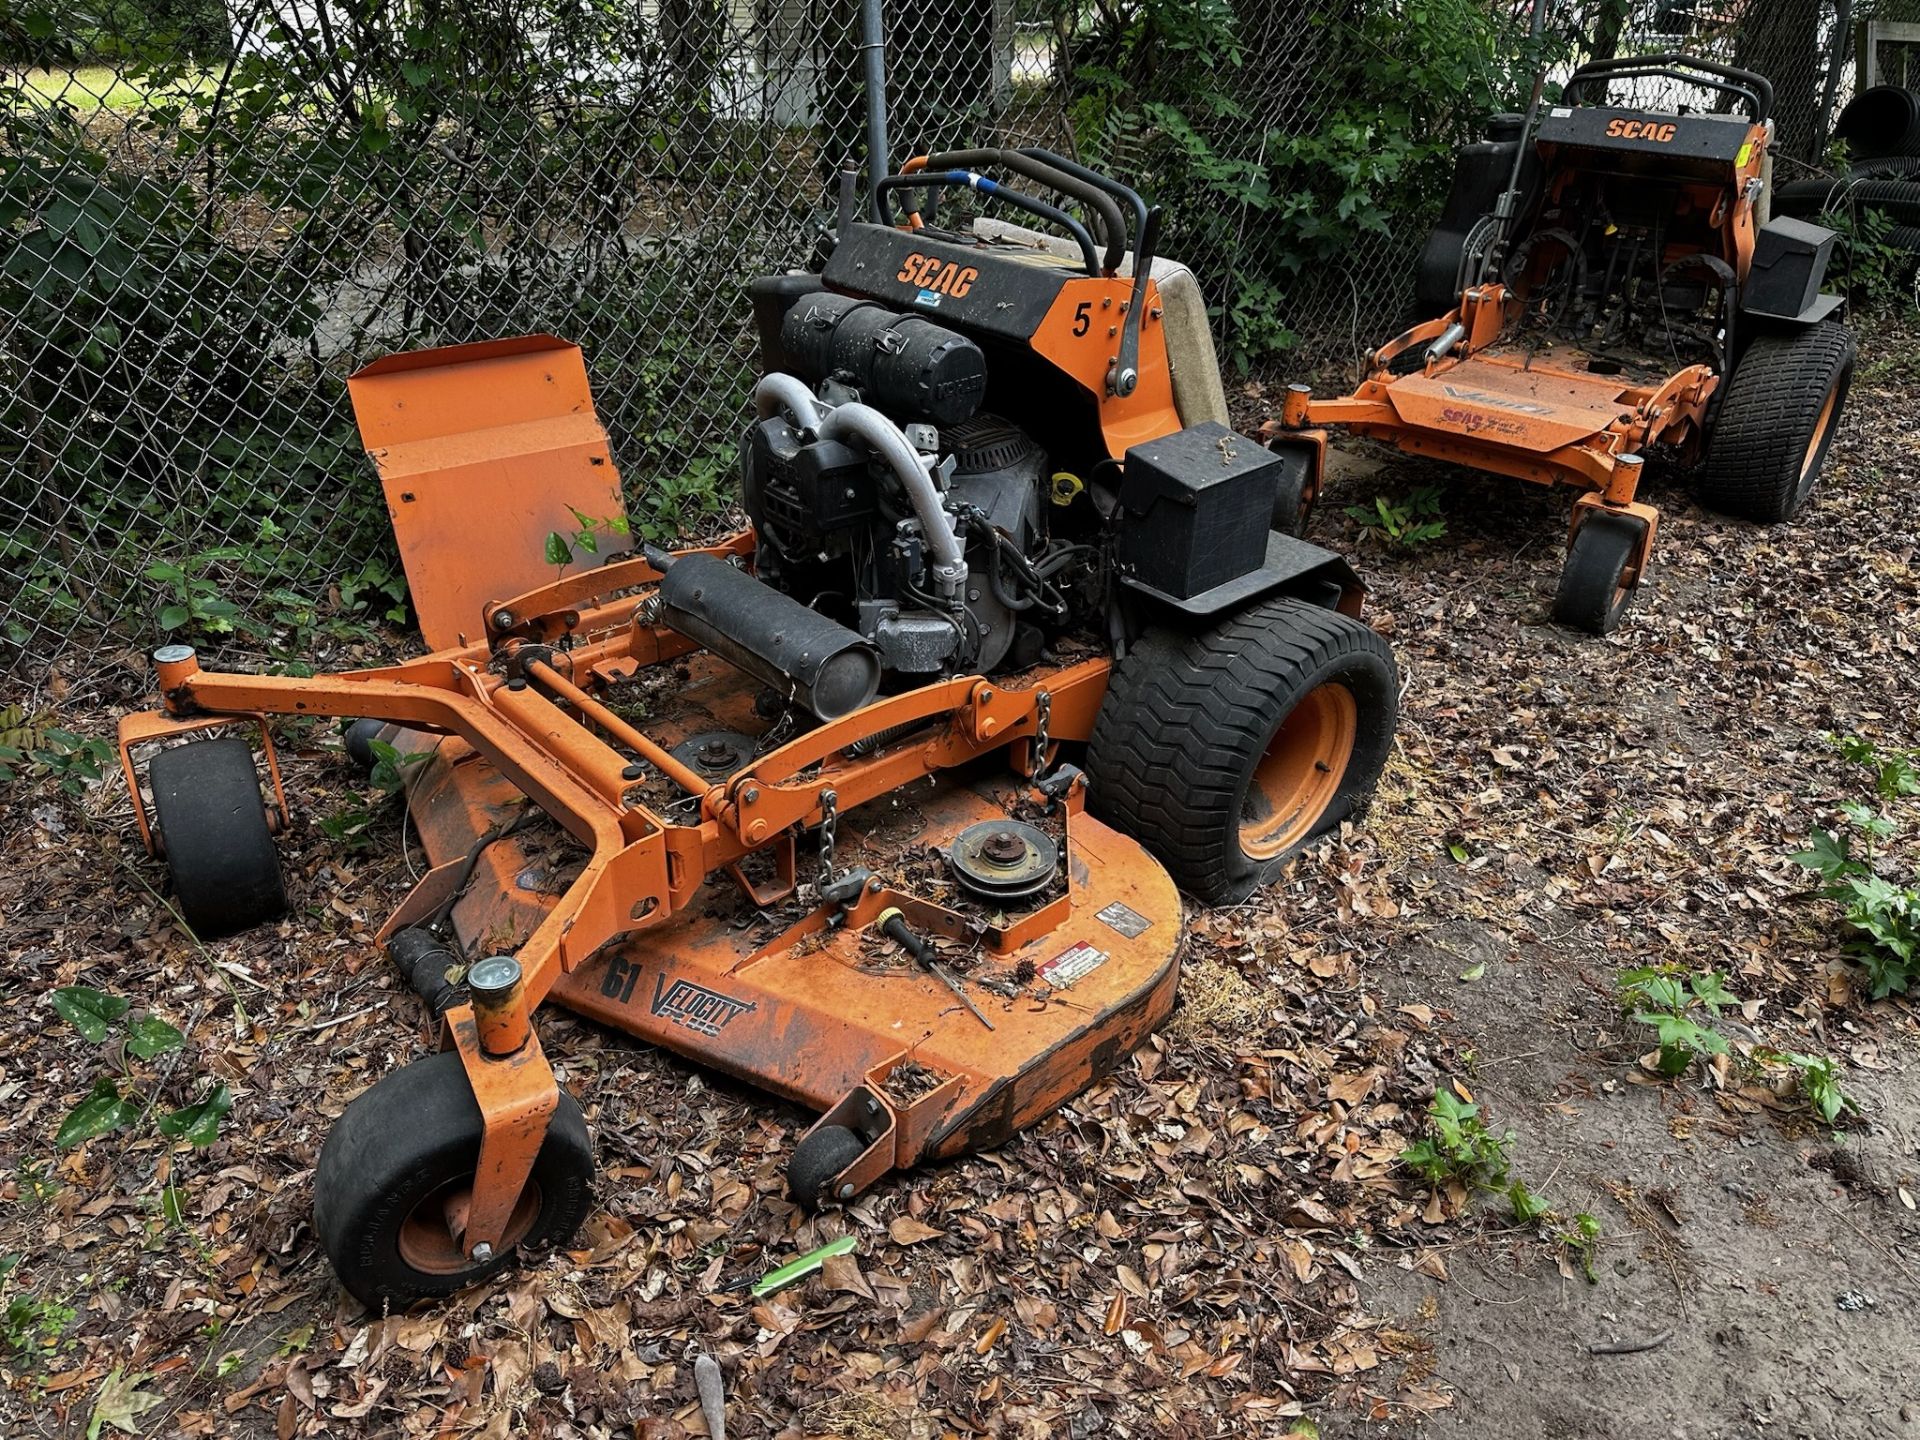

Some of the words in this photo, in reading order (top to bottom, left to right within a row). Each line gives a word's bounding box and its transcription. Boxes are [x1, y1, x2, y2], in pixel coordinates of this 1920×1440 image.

[1606, 118, 1676, 142] SCAG
[897, 252, 979, 299] SCAG
[1072, 302, 1092, 337] 5
[1056, 946, 1081, 964] DANGER
[601, 957, 642, 1003] 61
